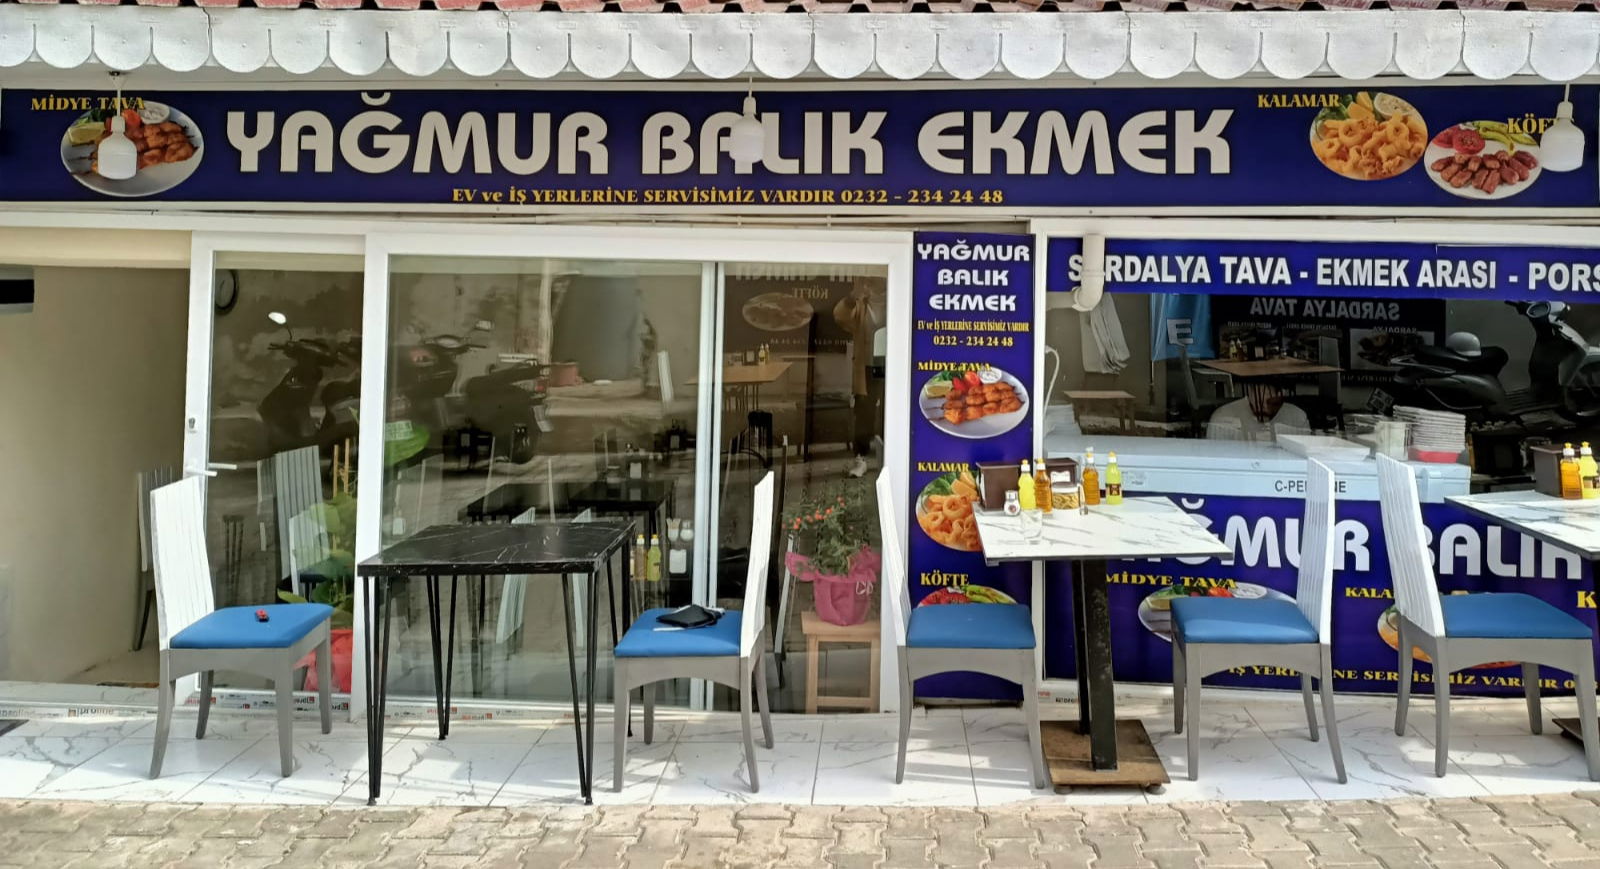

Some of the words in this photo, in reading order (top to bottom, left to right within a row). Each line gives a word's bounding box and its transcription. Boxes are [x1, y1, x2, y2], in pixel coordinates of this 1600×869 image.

[31, 94, 92, 111] MİDYE
[97, 97, 145, 111] TAVA
[1258, 94, 1340, 108] KALAMAR
[227, 91, 609, 174] YAĞMUR
[642, 111, 887, 174] BALIK
[917, 109, 1235, 175] EKMEK
[452, 188, 477, 202] EV
[481, 191, 502, 202] ve
[509, 186, 527, 205] İŞ
[532, 187, 638, 203] YERLERİNE
[643, 187, 755, 203] SERVİSİMİZ
[760, 189, 835, 203] VARDIR
[841, 190, 888, 203] 0232
[908, 190, 943, 204] 234
[949, 190, 976, 204] 24
[979, 190, 1004, 204] 48
[917, 239, 1030, 261] YAĞMUR
[937, 268, 1009, 286] BALIK
[1068, 254, 1212, 284] SRDALYA
[1219, 256, 1291, 285] TAVA
[1317, 258, 1410, 287] EKMEK
[1416, 260, 1496, 289] ARASI
[929, 294, 1017, 311] EKMEK
[933, 335, 957, 346] 0232
[966, 336, 984, 346] 234
[987, 337, 999, 347] 24
[1001, 337, 1014, 347] 48
[918, 360, 957, 371] MİDYE
[918, 462, 969, 472] KALAMAR
[921, 569, 969, 586] KÖFTE
[1106, 571, 1174, 586] MİDYE
[1180, 576, 1238, 590] TAVA
